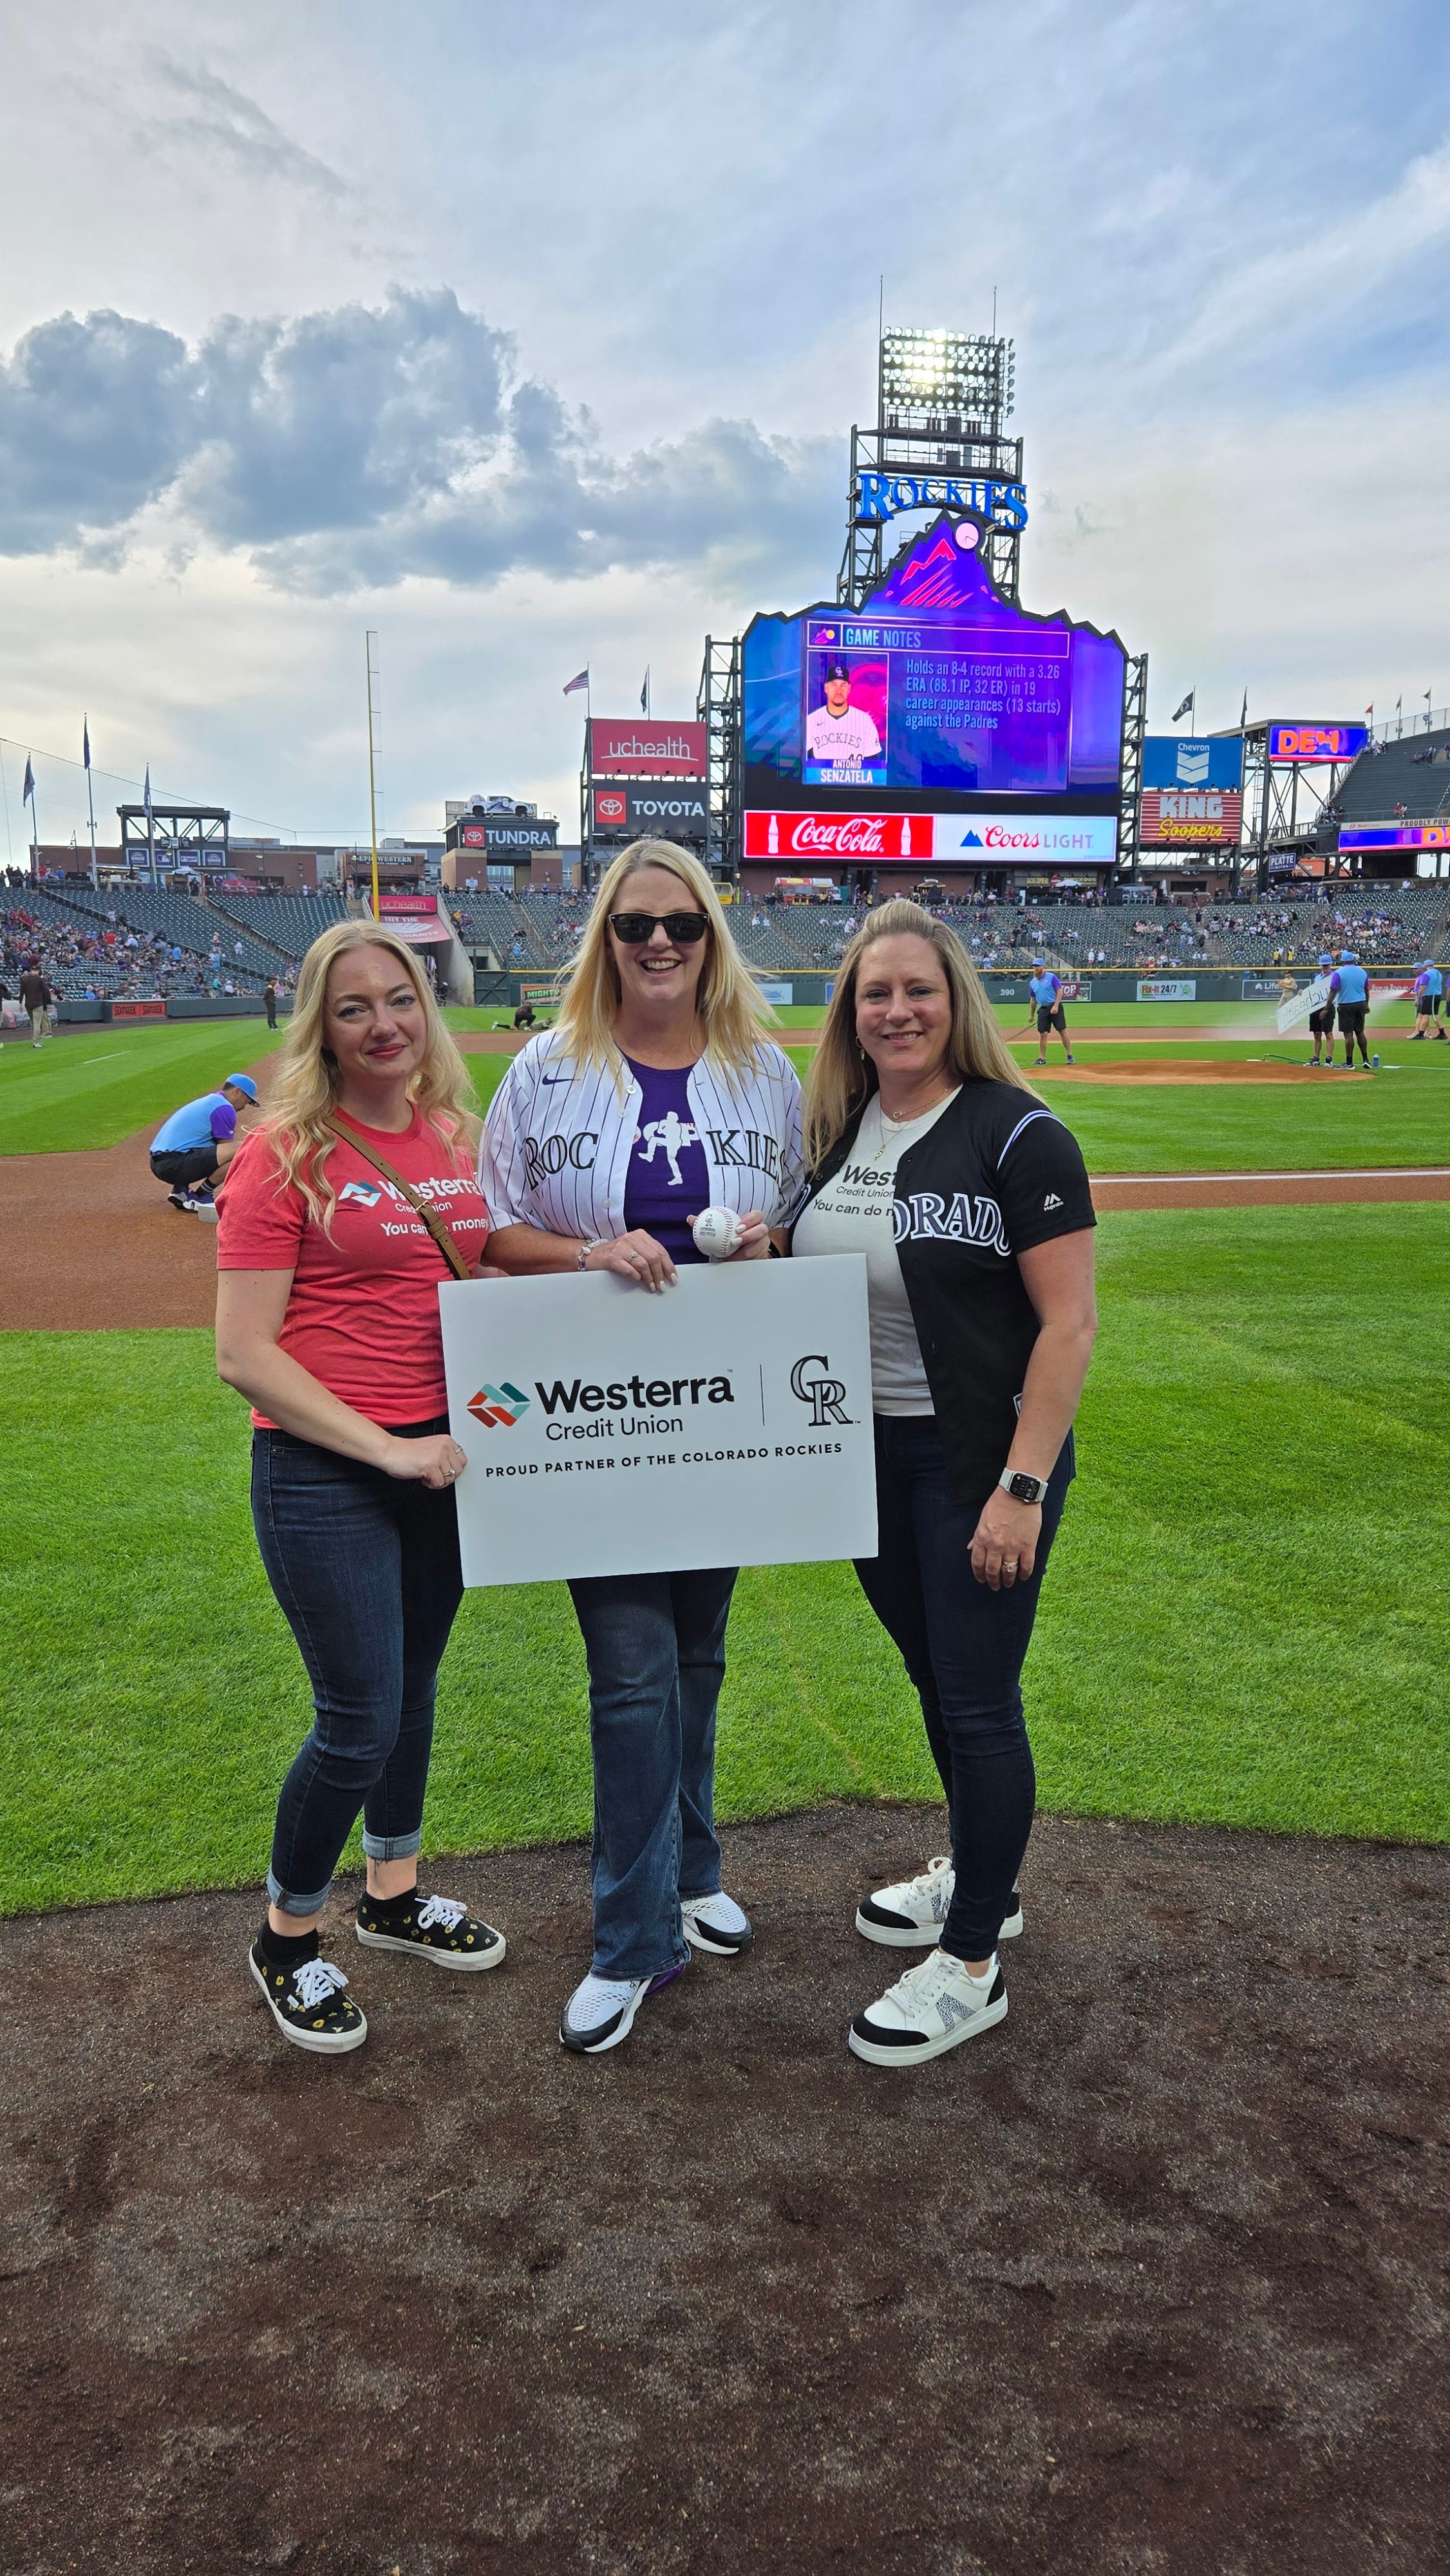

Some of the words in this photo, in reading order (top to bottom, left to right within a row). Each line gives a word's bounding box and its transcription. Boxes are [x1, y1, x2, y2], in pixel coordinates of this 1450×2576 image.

[856, 473, 1028, 529] ROCKIES
[846, 629, 880, 646] GAME
[883, 630, 921, 648] NOTES
[907, 659, 934, 674] Holds
[937, 663, 948, 675] an
[952, 661, 967, 675] 8-4
[970, 663, 1002, 677] record
[1005, 664, 1026, 677] with
[1029, 667, 1034, 677] a
[1038, 665, 1060, 679] 3.26
[906, 677, 926, 692] ERA
[930, 678, 956, 694] (88.1
[960, 679, 971, 695] IP,
[975, 680, 987, 693] 32
[990, 680, 1008, 696] ER)
[1012, 681, 1020, 695] in
[1024, 681, 1035, 695] 19
[906, 697, 938, 709] career
[941, 699, 1003, 713] appearances
[1006, 698, 1023, 714] (13
[1026, 699, 1060, 715] starts)
[906, 713, 942, 730] against
[945, 714, 961, 728] the
[964, 714, 997, 729] Padres
[610, 735, 690, 758] uchealth
[814, 733, 862, 749] ROCKIES
[1178, 743, 1210, 751] Chevron
[833, 760, 862, 769] ANTONIO
[821, 770, 873, 783] SENZATELA
[632, 800, 705, 817] TOYOTA
[1160, 797, 1223, 819] KING
[485, 830, 551, 844] TUNDRA
[791, 817, 888, 851] Coca-Cola
[985, 826, 1040, 848] Coors
[1044, 835, 1093, 849] LIGHT
[1157, 818, 1223, 842] Soopers
[1271, 855, 1294, 866] PLATTE
[381, 900, 426, 909] uchealth
[1161, 985, 1176, 993] 24/7
[115, 1006, 136, 1016] SEATGEEK
[143, 1005, 162, 1015] SEATGEEK
[525, 1132, 598, 1191] ROC
[836, 1186, 865, 1197] Credit
[431, 1202, 453, 1213] nion
[813, 1198, 833, 1211] You
[836, 1204, 860, 1215] can
[864, 1205, 881, 1216] do
[381, 1222, 408, 1236] You
[411, 1224, 428, 1235] can
[535, 1375, 734, 1415] Westerra
[546, 1419, 614, 1441] Credit
[621, 1415, 683, 1435] Union
[486, 1464, 538, 1477] PROUD
[545, 1459, 615, 1473] PARTNER
[621, 1457, 641, 1467] OF
[647, 1454, 675, 1465] THE
[683, 1448, 769, 1463] COLORADO
[775, 1443, 842, 1457] ROCKIES
